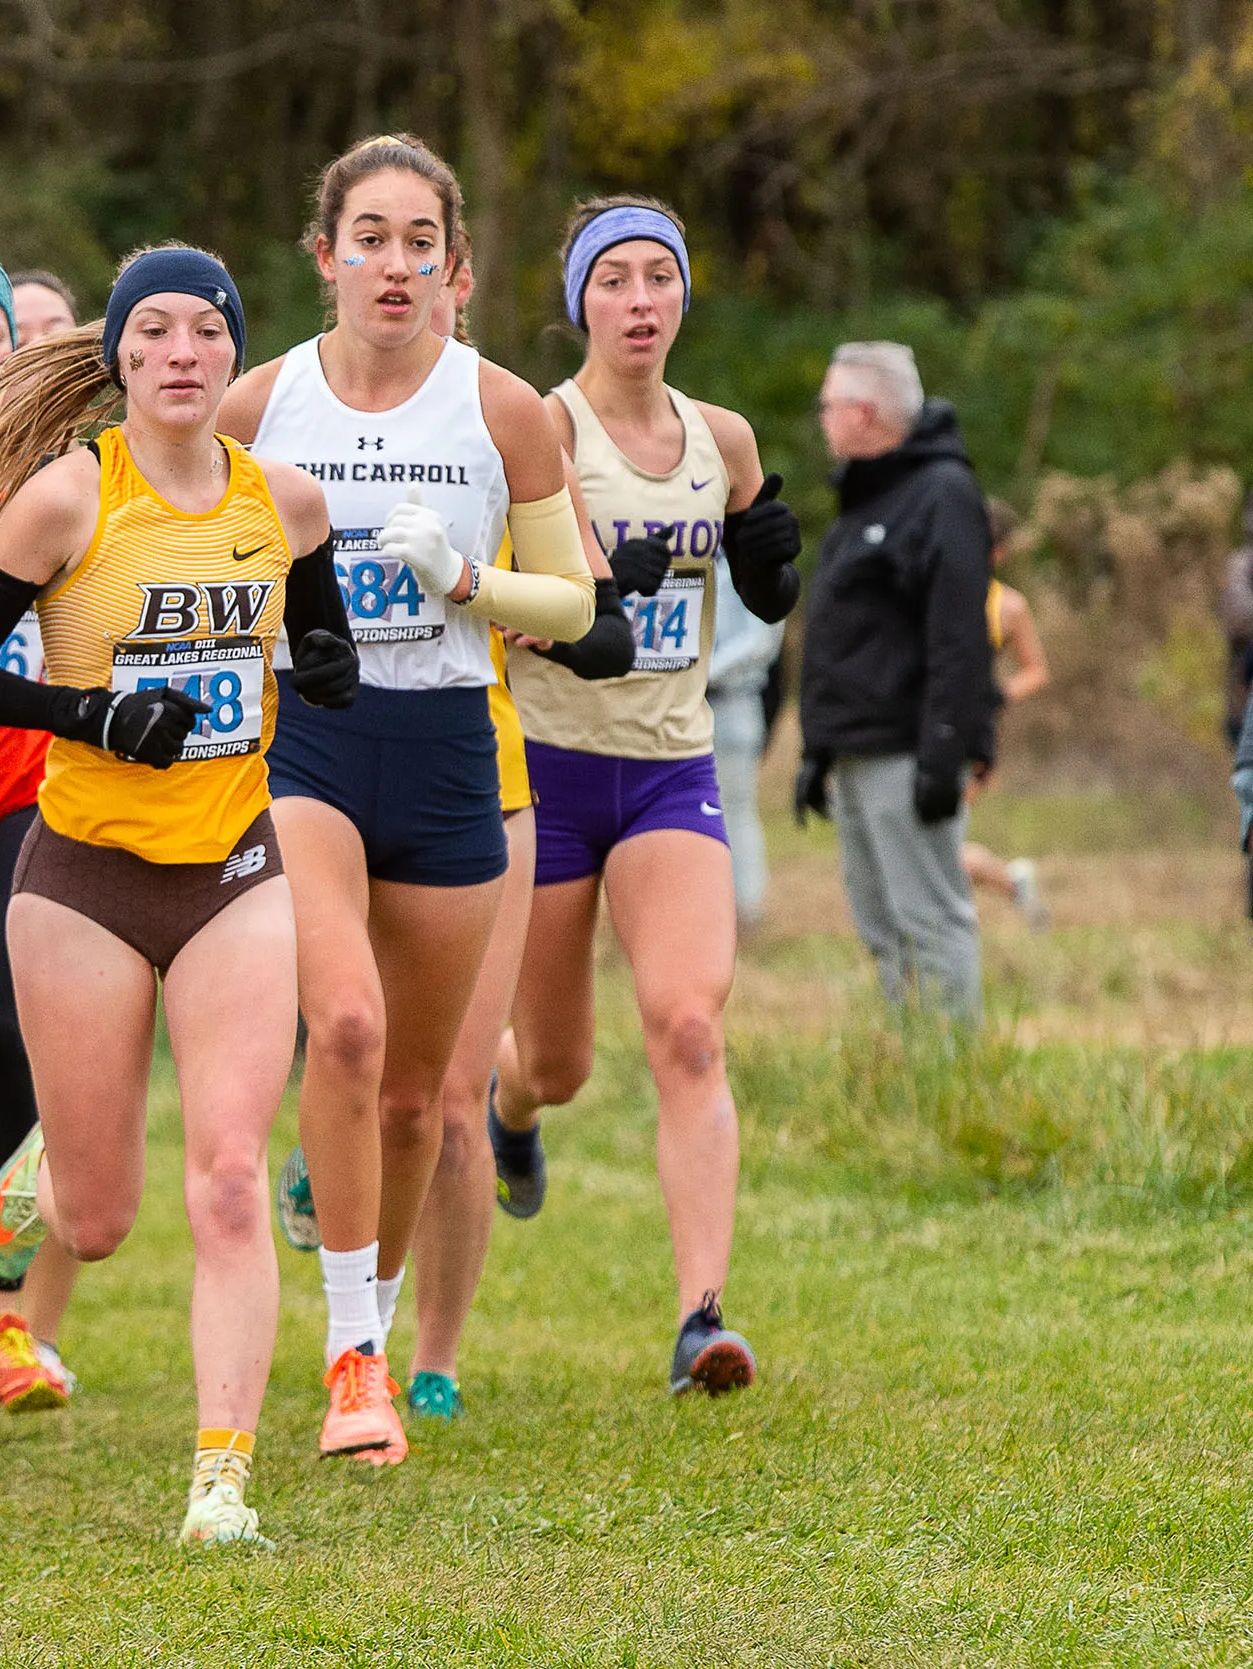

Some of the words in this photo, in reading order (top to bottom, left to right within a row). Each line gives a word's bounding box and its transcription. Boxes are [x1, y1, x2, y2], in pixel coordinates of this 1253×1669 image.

[296, 463, 346, 481] HN
[352, 463, 470, 485] CARROLL
[342, 529, 369, 539] NCAA
[338, 540, 379, 551] LAKES
[122, 580, 277, 639] BW
[620, 598, 688, 648] 14
[352, 627, 434, 642] PIONSHIPS
[166, 642, 191, 651] NCAA
[195, 639, 216, 650] DIII
[114, 654, 159, 666] GREAT
[160, 651, 199, 665] LAKES
[200, 646, 263, 662] REGIONAL
[635, 657, 691, 670] IONSHIPS
[180, 741, 250, 761] IONSHIPS
